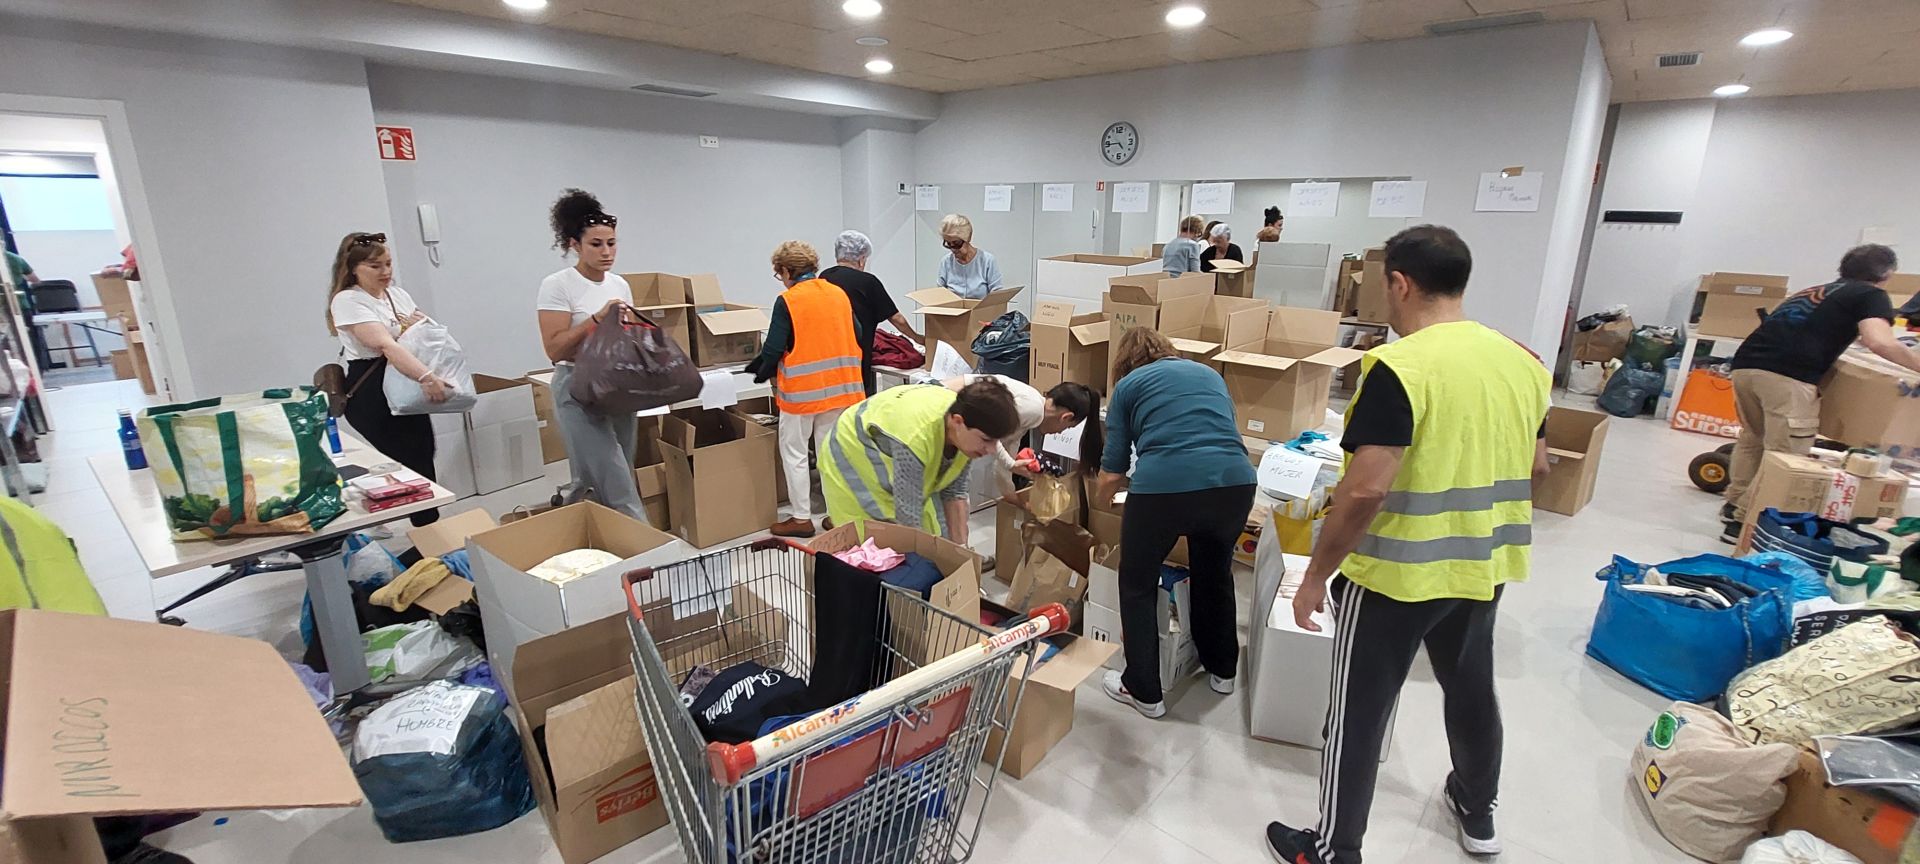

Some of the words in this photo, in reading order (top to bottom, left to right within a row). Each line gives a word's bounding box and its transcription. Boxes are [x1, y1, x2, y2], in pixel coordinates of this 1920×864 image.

[1115, 126, 1124, 134] 12
[1105, 140, 1110, 148] 9
[1128, 138, 1133, 146] 3
[1116, 152, 1122, 160] 6
[396, 718, 454, 733] HOMBRE
[773, 703, 856, 748] Alcampo
